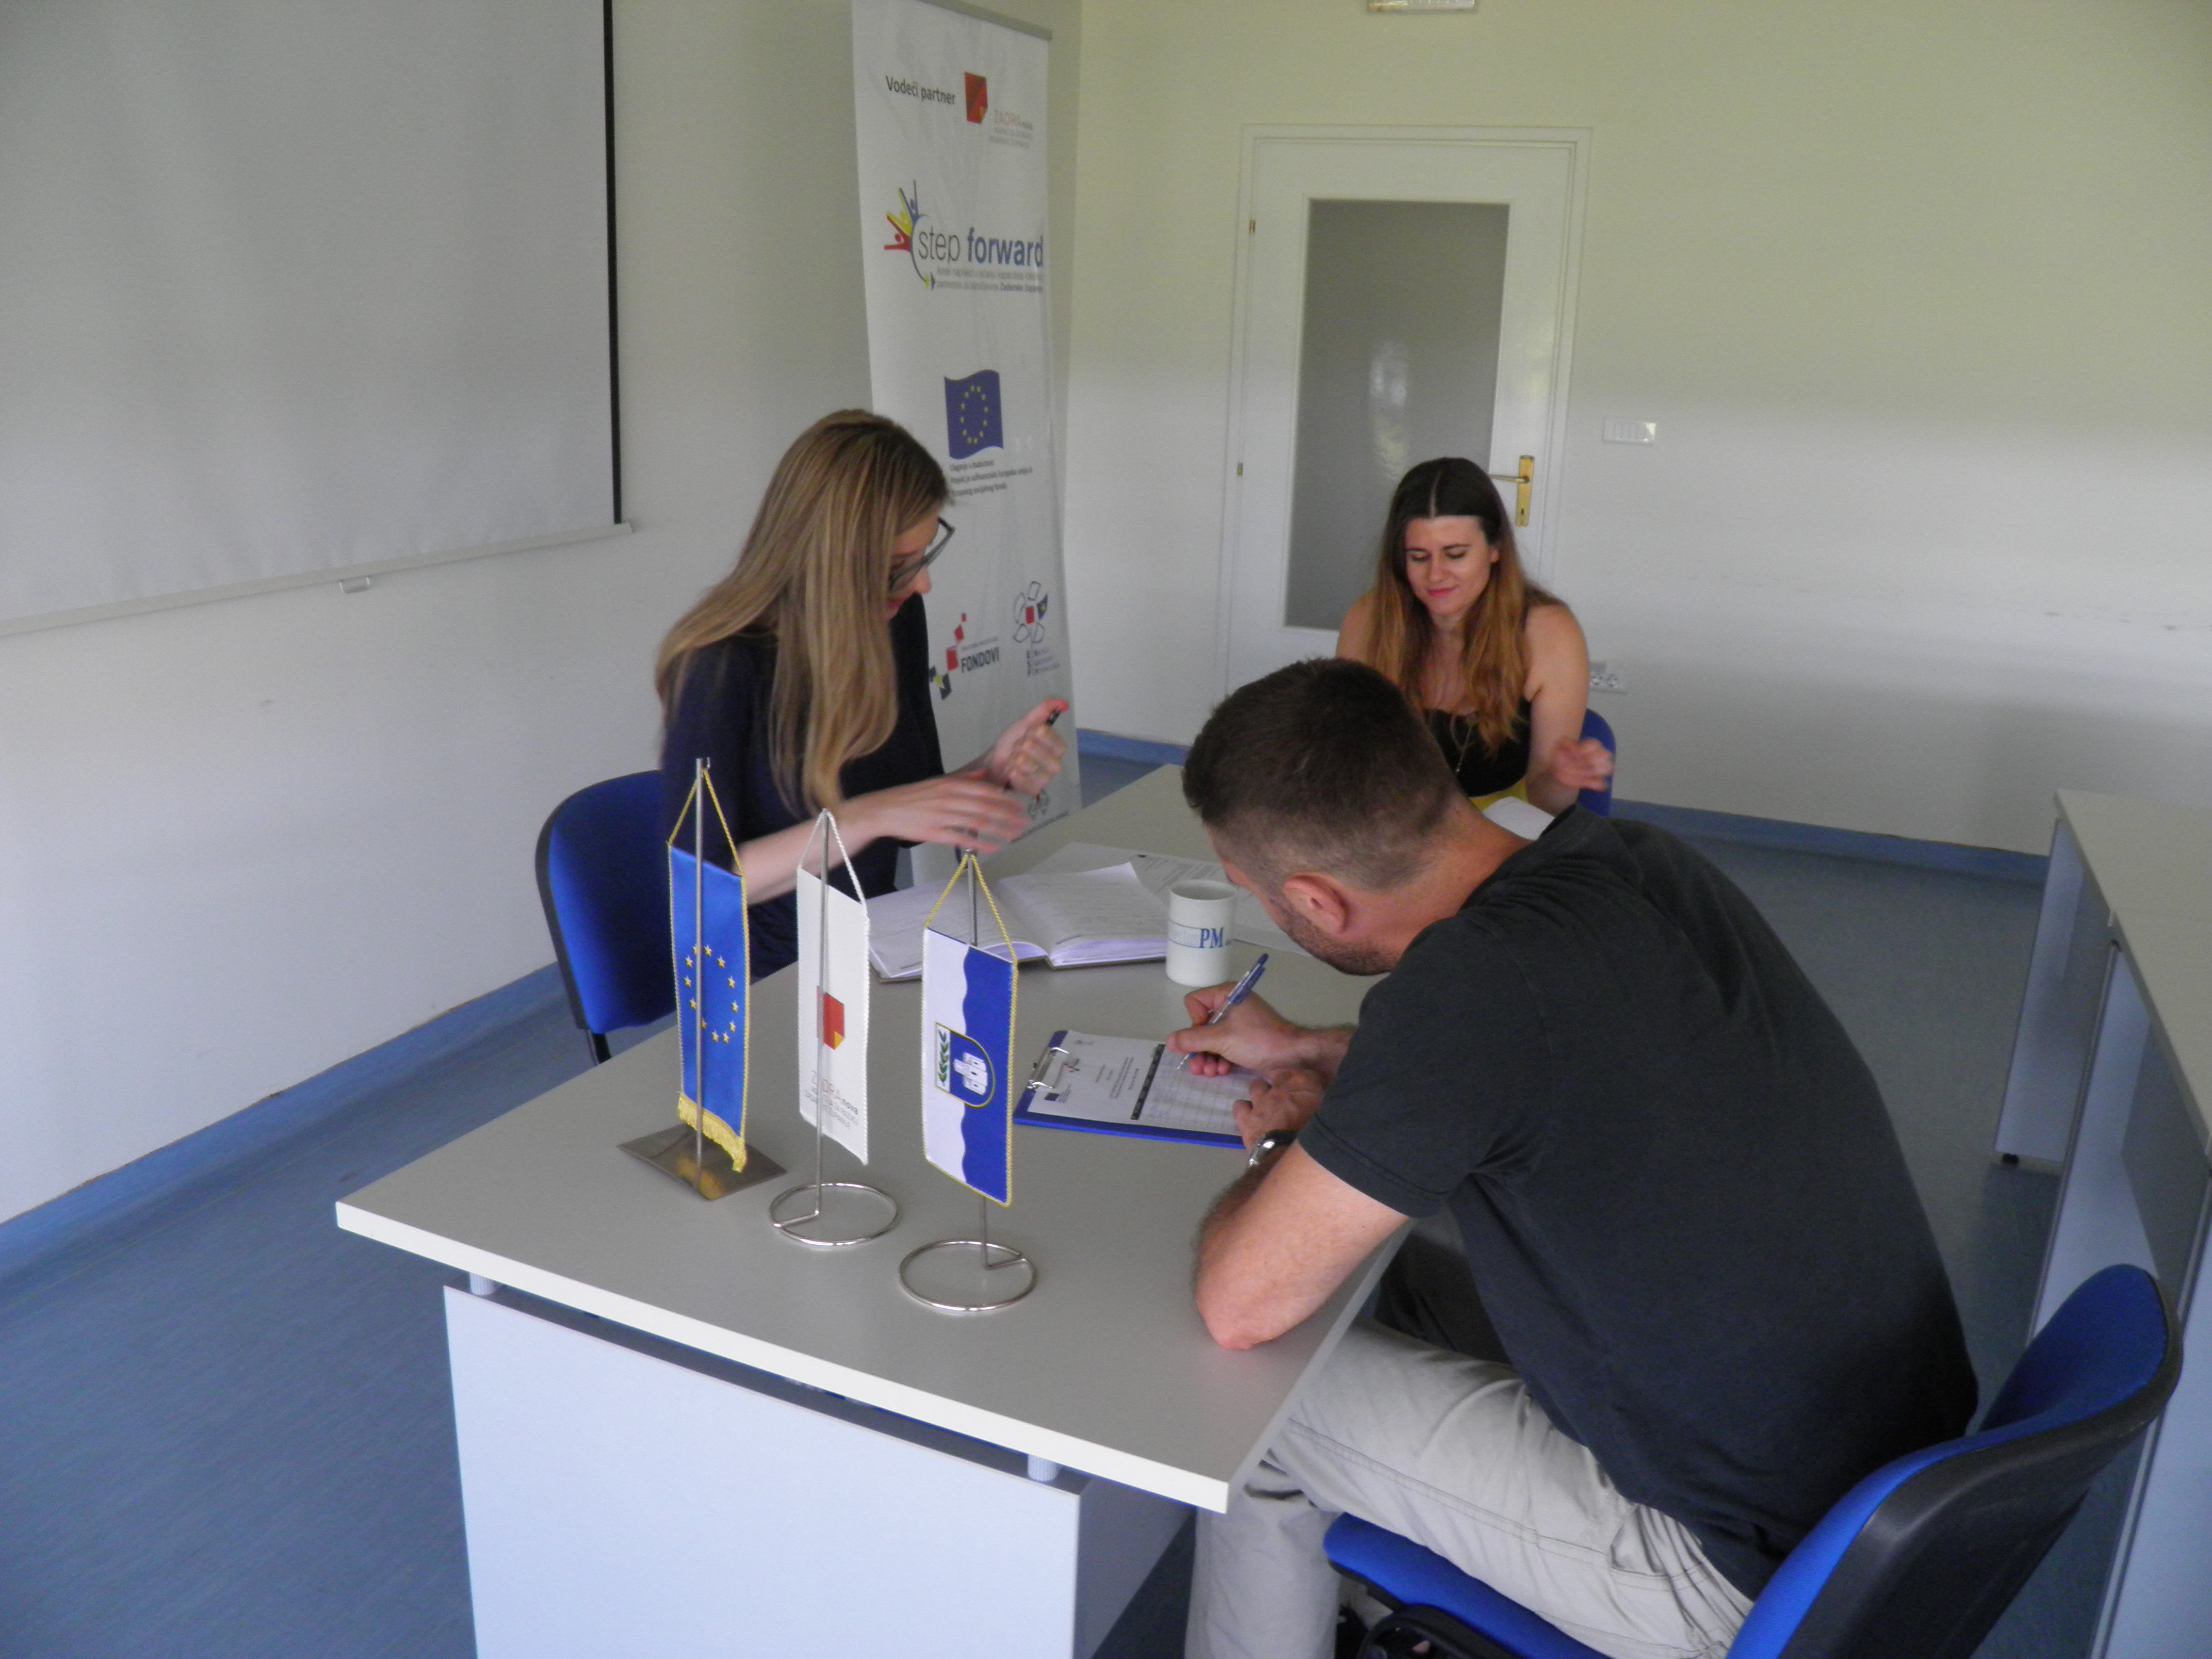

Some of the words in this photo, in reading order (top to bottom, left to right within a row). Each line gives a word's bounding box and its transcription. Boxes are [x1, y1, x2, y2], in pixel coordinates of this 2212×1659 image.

[886, 75, 919, 97] Vodeći
[921, 87, 956, 105] partner
[918, 226, 961, 264] step
[967, 226, 1043, 267] forward
[961, 646, 1000, 674] FONDOVI
[1199, 927, 1225, 949] PM
